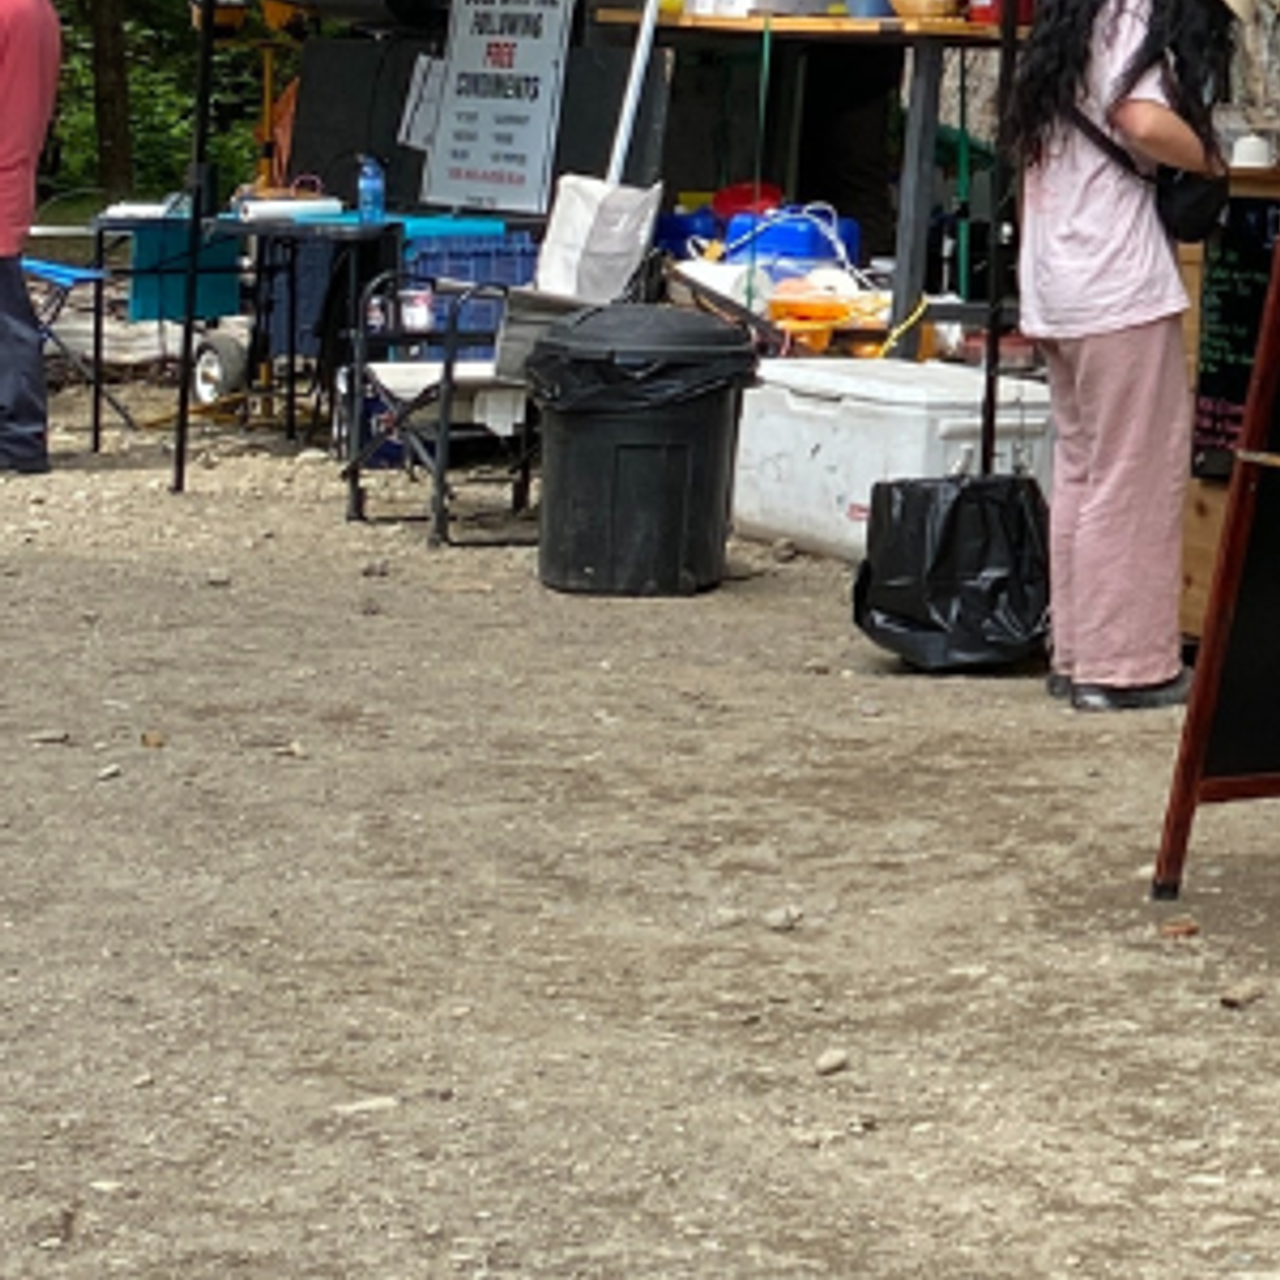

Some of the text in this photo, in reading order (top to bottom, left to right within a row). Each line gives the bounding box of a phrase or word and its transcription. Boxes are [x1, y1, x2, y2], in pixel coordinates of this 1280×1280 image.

[470, 10, 543, 38] FOLLOWING
[483, 42, 517, 69] FREE
[456, 73, 540, 101] CONDIMENTS
